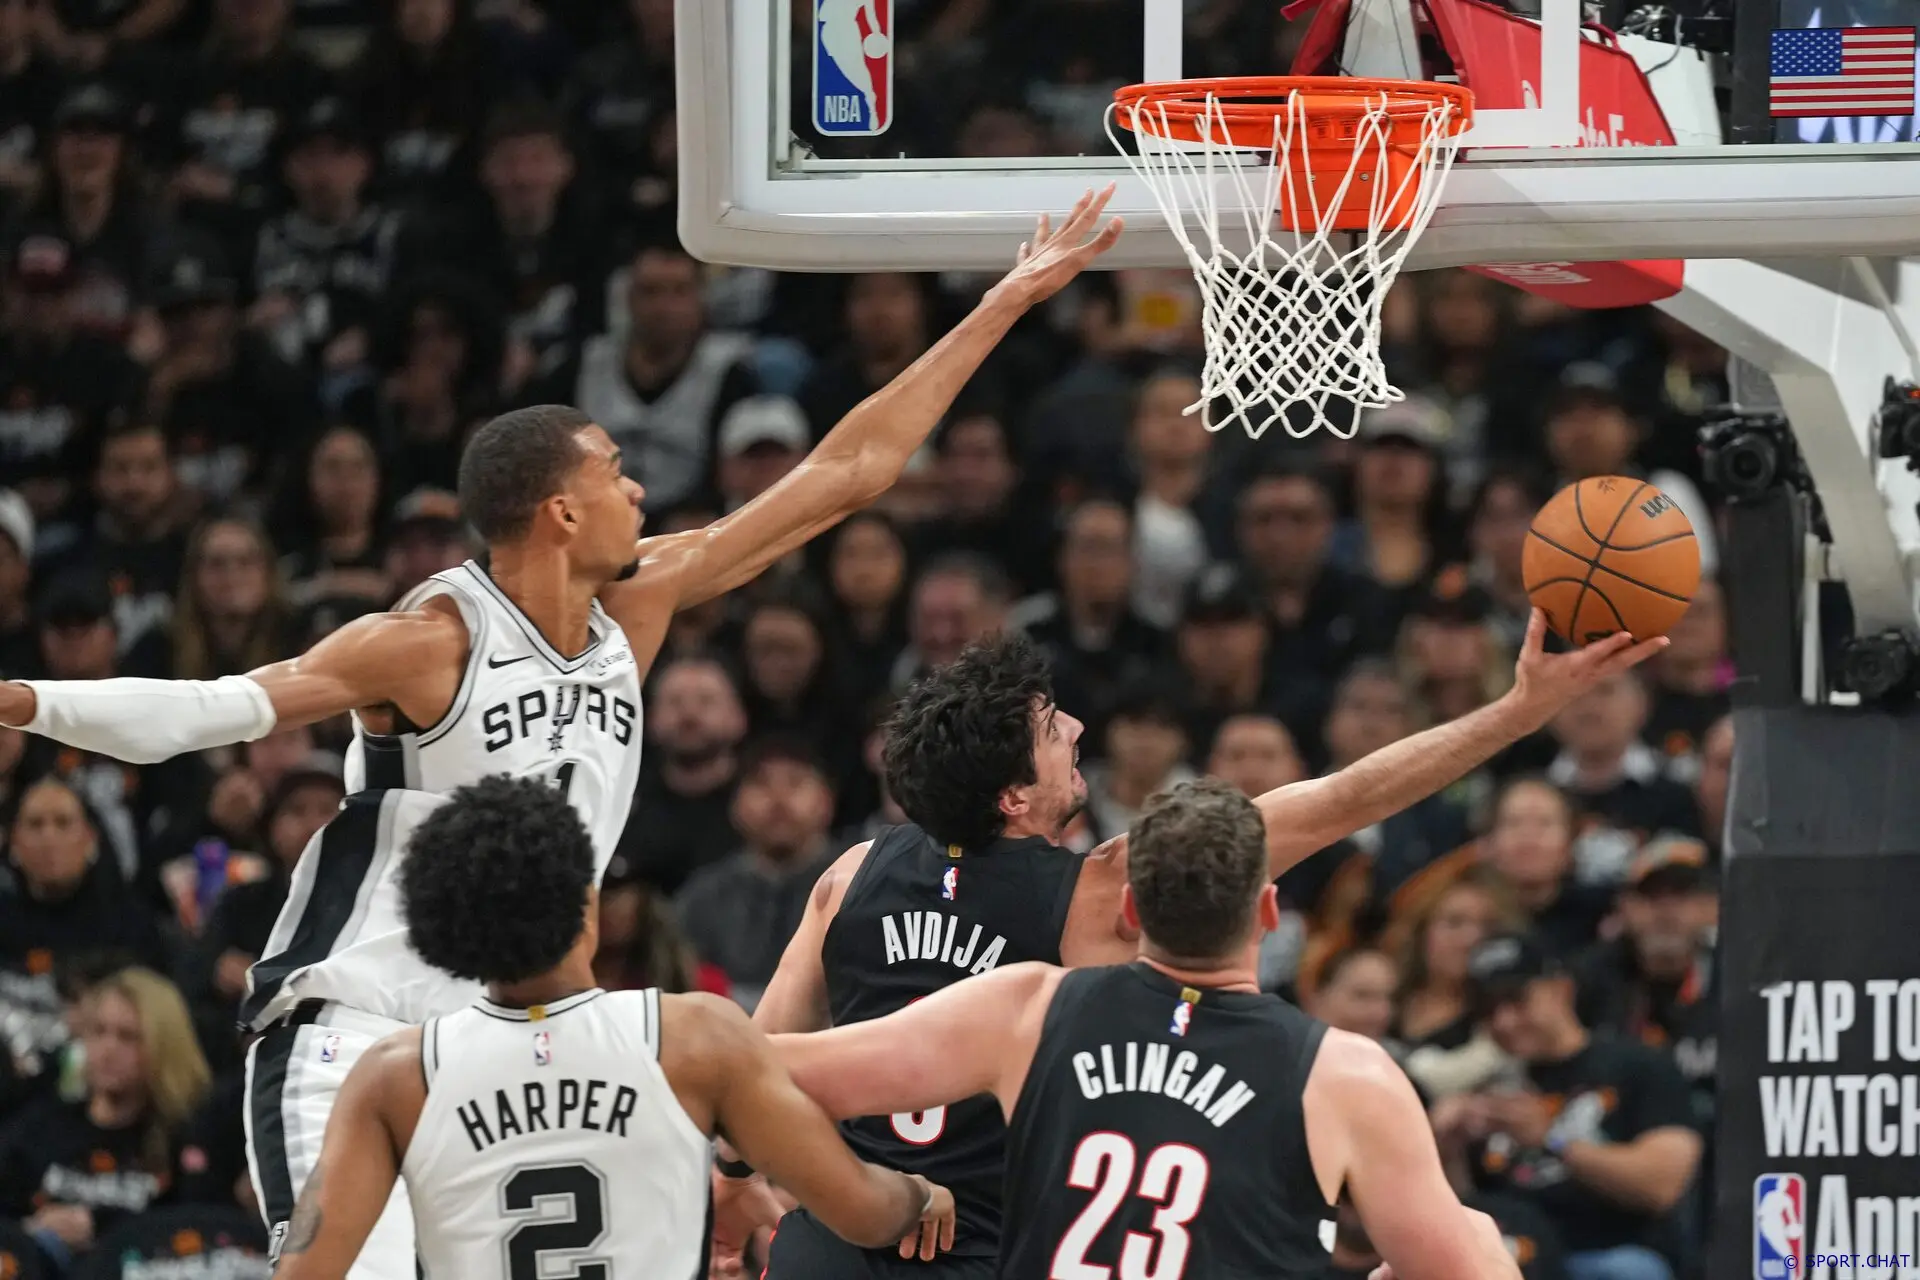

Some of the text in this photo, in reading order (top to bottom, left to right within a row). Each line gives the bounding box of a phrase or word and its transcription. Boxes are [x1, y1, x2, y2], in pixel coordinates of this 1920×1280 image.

[824, 95, 861, 122] NBA
[483, 684, 636, 753] SPURS
[881, 911, 1008, 975] AVDIJA
[1760, 980, 1855, 1063] TAP
[1865, 978, 1920, 1061] TO
[456, 1079, 638, 1152] HARPER
[1072, 1041, 1256, 1128] CLINGAN
[497, 1158, 613, 1280] 2
[1049, 1130, 1211, 1280] 23
